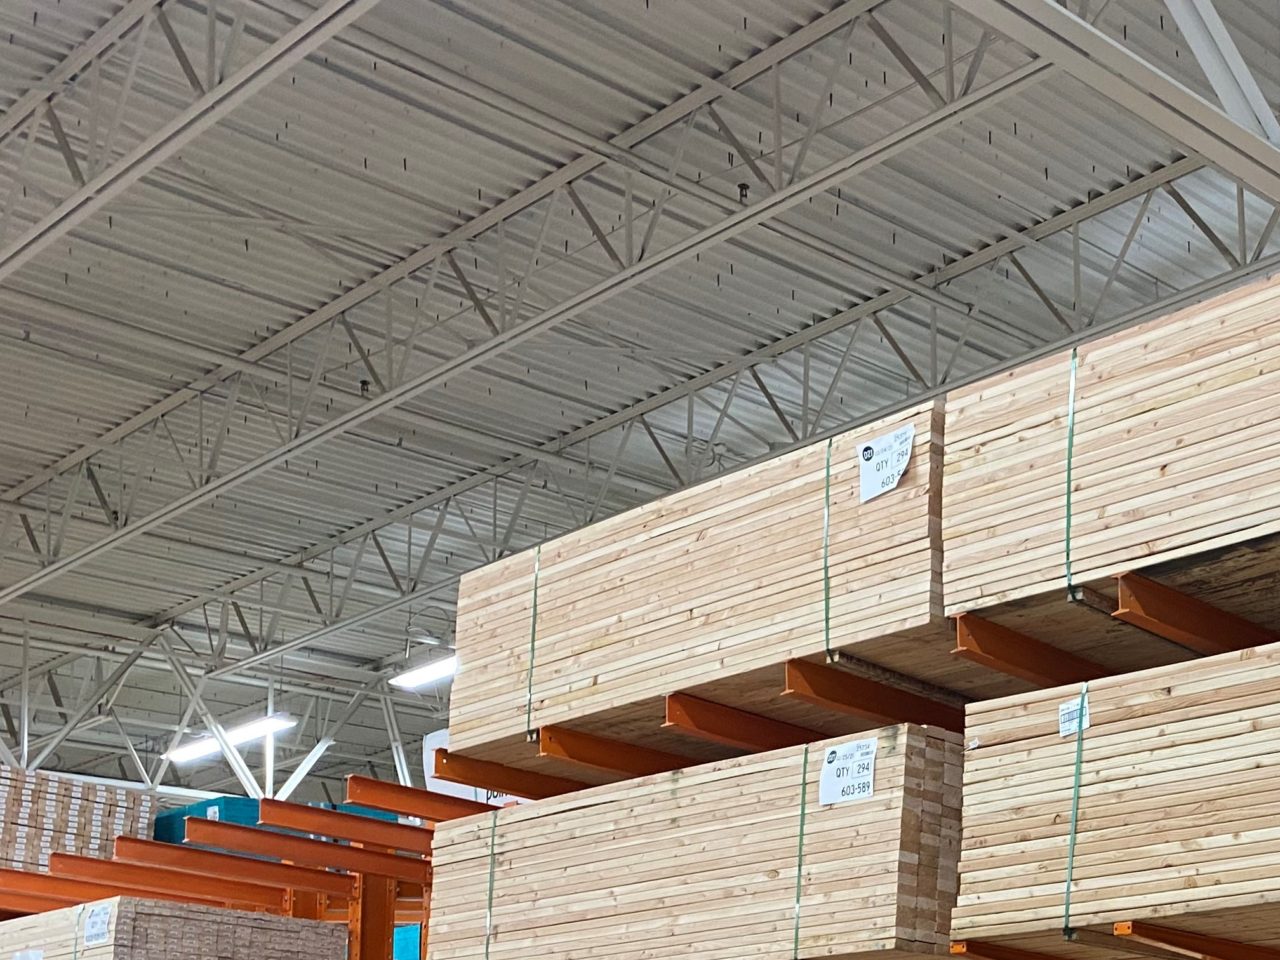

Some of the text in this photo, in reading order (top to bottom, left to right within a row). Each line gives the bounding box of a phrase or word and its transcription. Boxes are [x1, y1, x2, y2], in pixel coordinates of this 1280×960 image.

[876, 458, 889, 472] QTY
[836, 762, 870, 778] QTY 294
